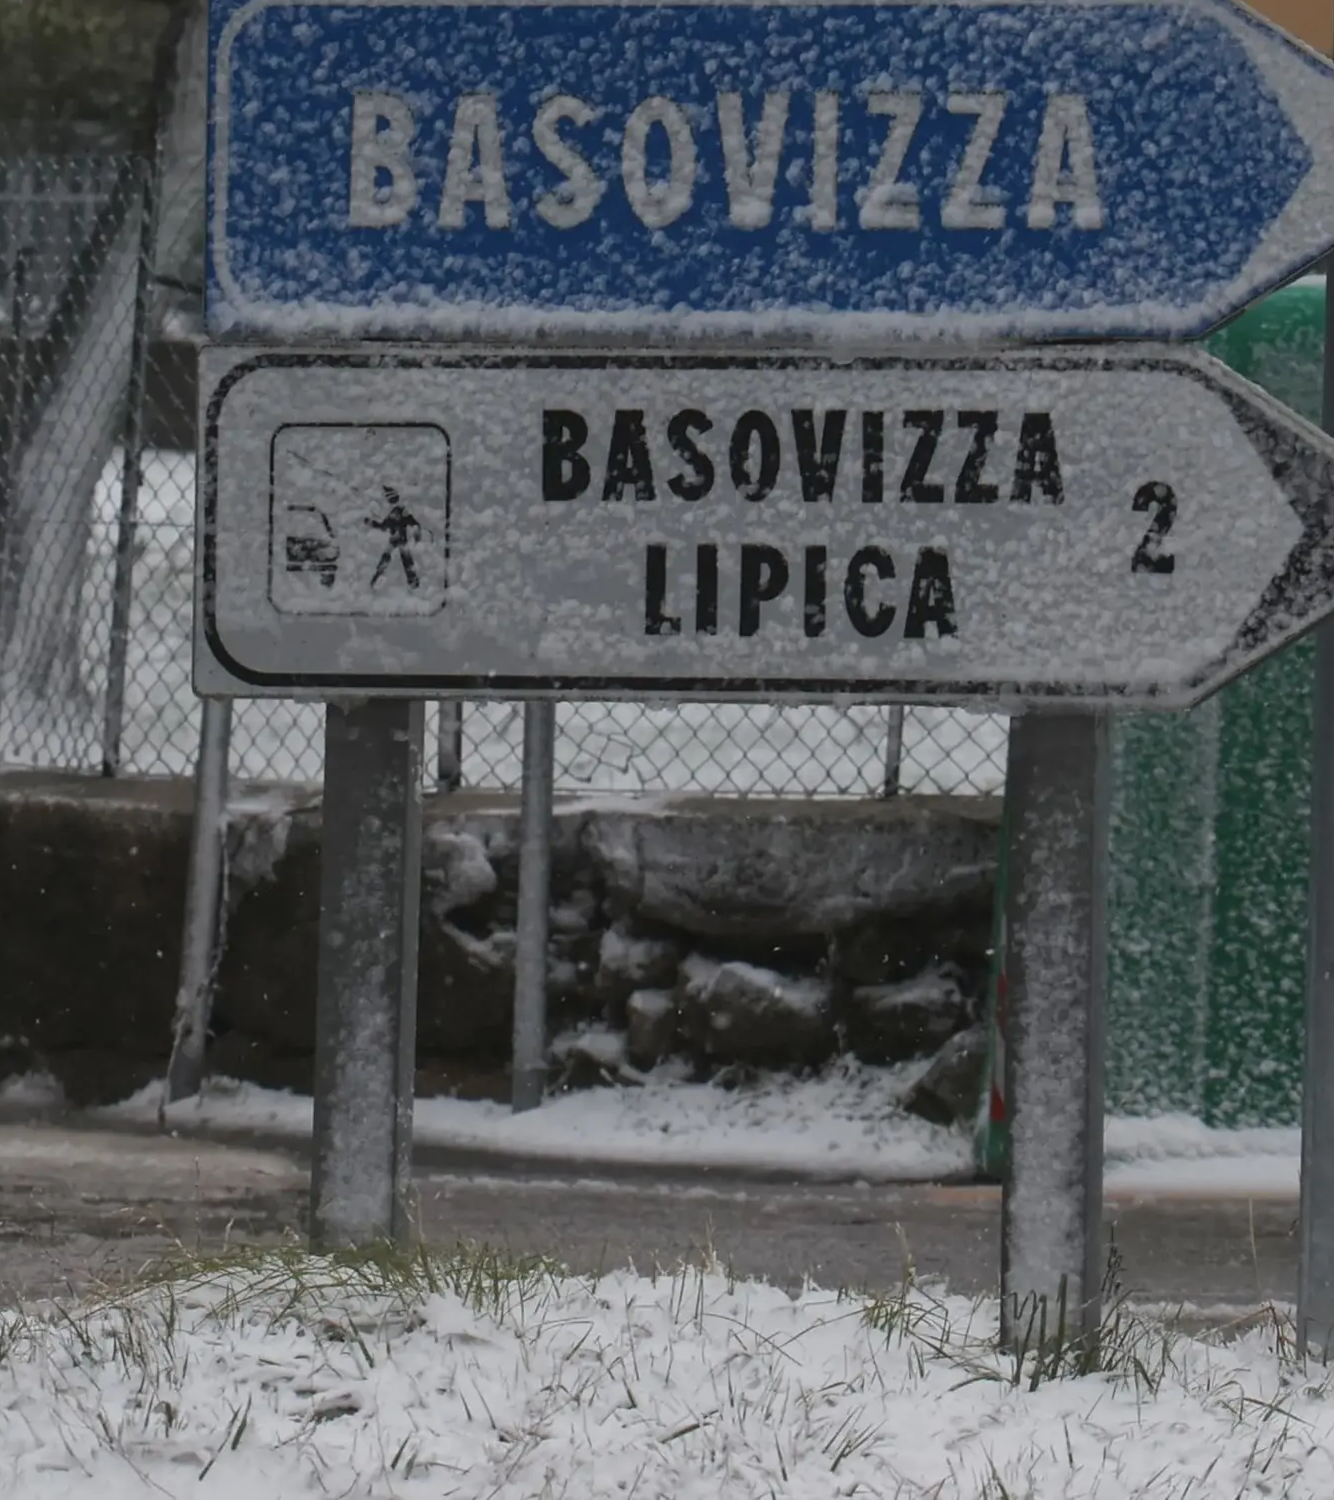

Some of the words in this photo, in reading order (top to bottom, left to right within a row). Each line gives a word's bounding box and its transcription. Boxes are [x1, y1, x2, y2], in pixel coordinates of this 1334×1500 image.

[349, 91, 1105, 232] BASOVIZZA
[541, 408, 1067, 505] BASOVIZZA
[1131, 481, 1179, 574] 2
[644, 543, 958, 638] LIPICA
